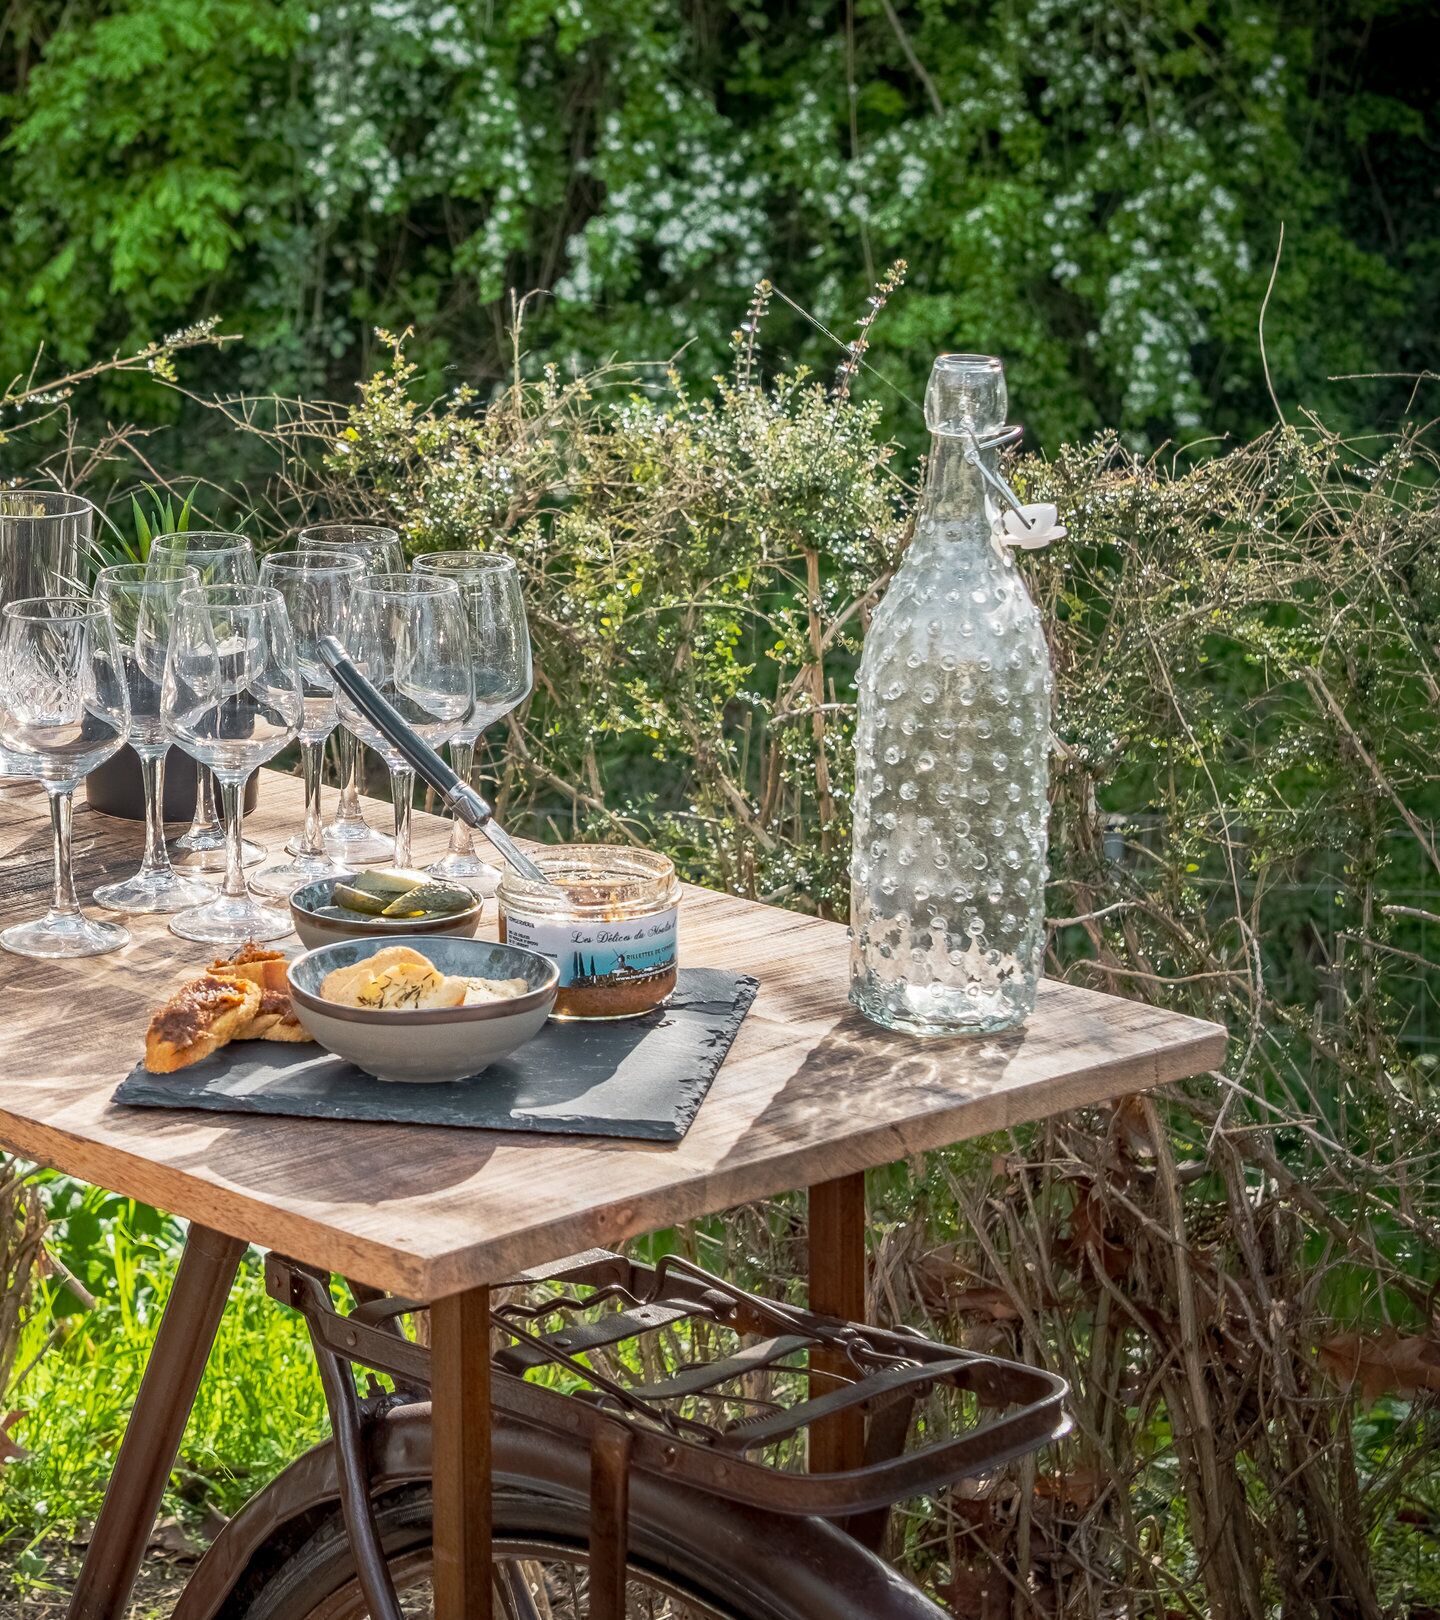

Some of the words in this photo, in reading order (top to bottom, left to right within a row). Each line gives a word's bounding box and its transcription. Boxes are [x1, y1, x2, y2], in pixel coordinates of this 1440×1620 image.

[570, 931, 593, 944] Les
[597, 930, 631, 944] Délices
[633, 929, 646, 940] du
[626, 951, 654, 961] RILLETTES
